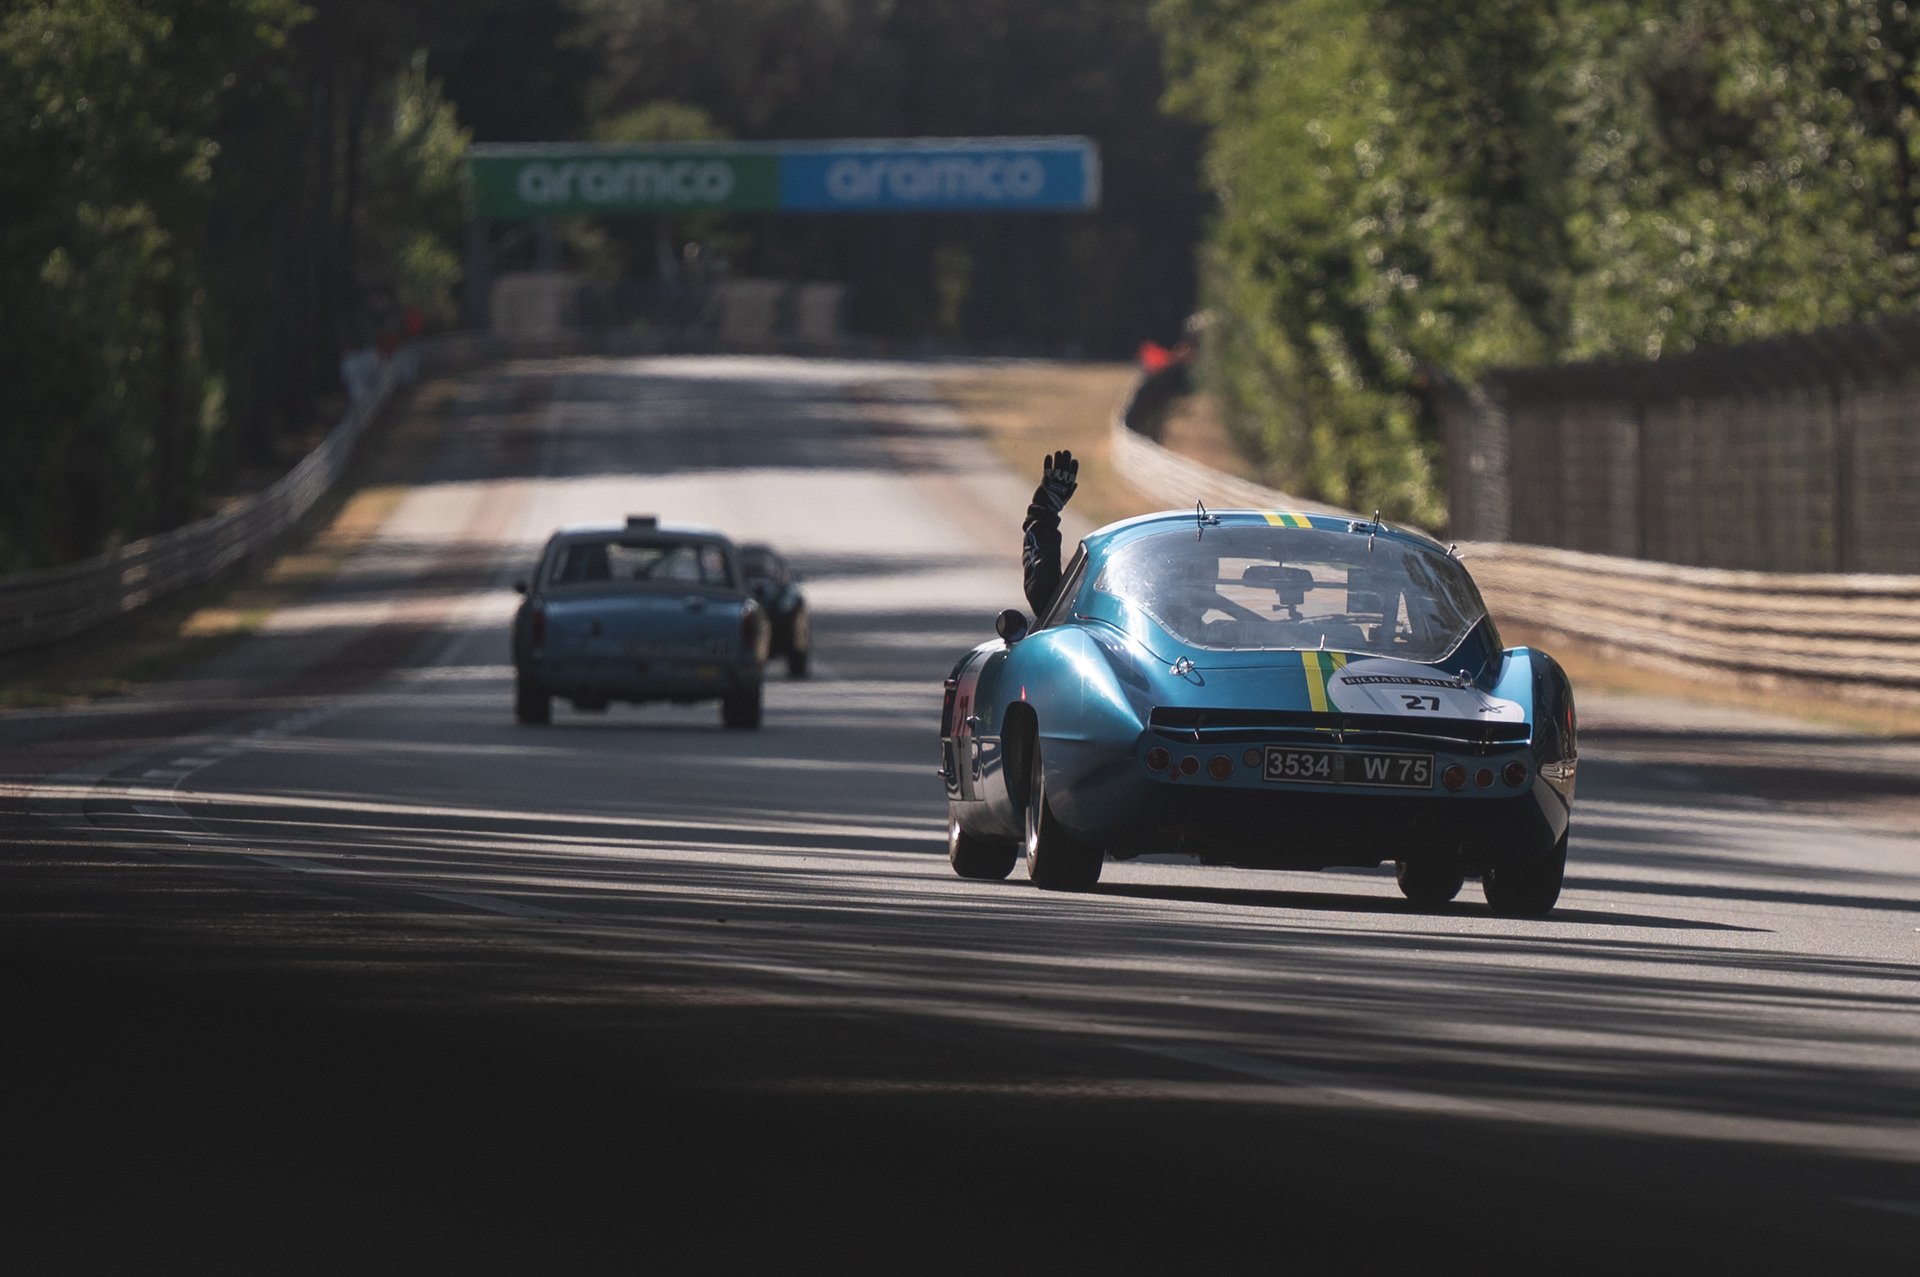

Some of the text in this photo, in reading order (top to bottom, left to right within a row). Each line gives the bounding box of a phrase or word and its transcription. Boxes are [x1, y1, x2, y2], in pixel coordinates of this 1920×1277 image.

[518, 161, 735, 202] aramco
[827, 157, 1044, 200] aramco
[1345, 676, 1412, 684] RICHARD
[1401, 695, 1440, 711] 27
[1269, 752, 1428, 782] 3534 W 75
